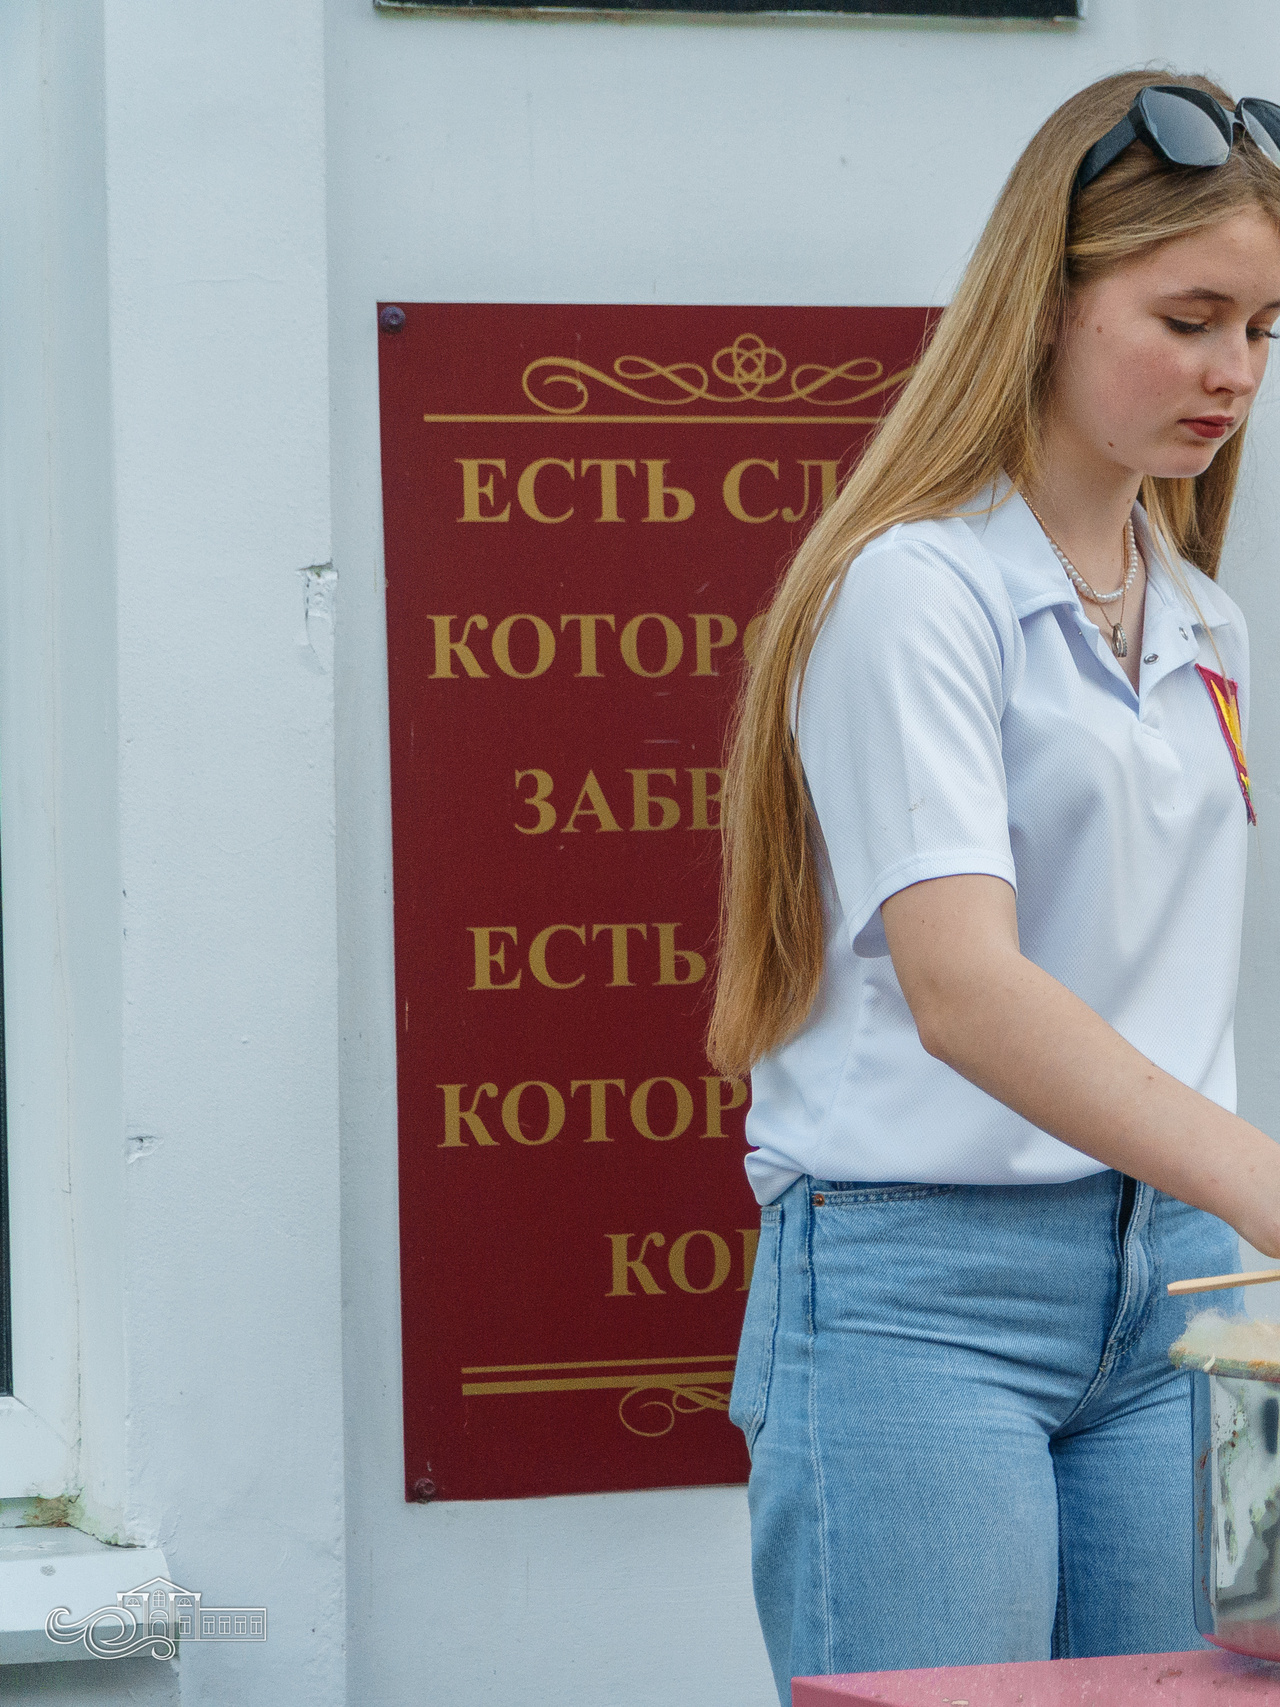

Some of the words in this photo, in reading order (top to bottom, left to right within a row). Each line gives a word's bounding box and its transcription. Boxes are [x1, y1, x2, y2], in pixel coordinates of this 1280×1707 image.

[455, 457, 696, 524] ЕСТЬ
[466, 922, 707, 992] ЕСТЬ
[436, 1075, 749, 1149] КОТОР
